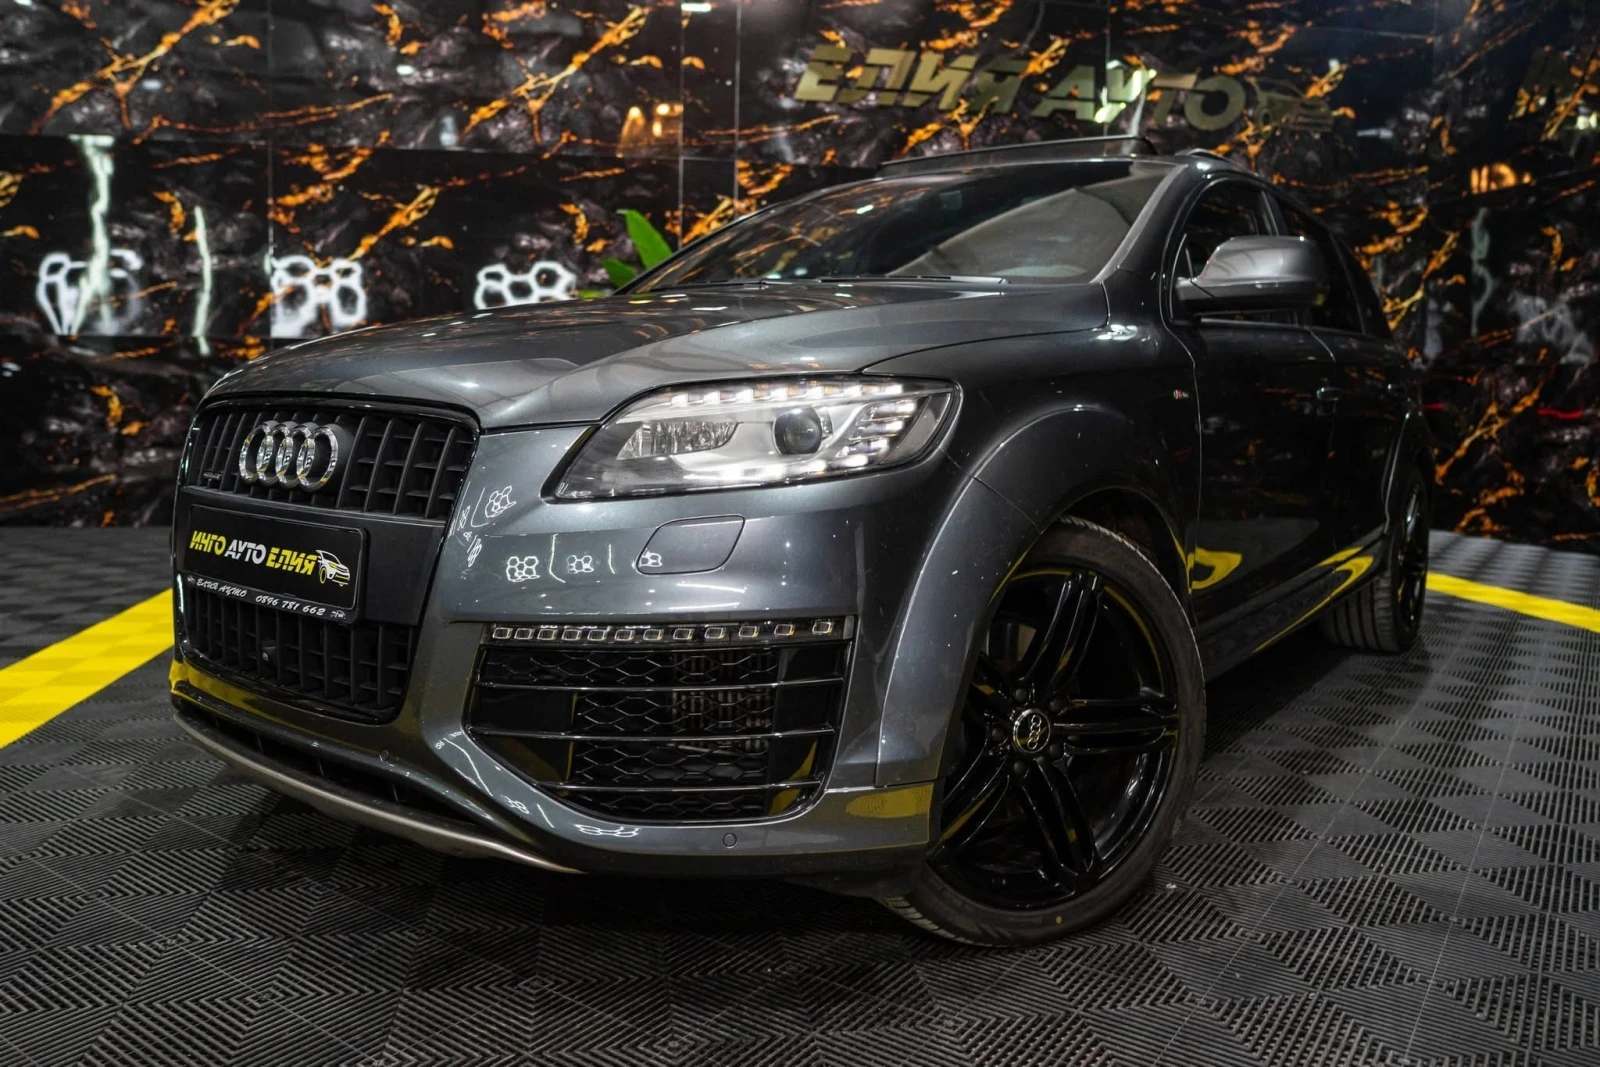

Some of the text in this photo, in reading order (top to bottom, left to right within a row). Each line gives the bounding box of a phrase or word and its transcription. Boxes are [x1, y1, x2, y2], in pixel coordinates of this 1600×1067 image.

[794, 44, 1246, 131] ЕЛИЯ АУТО
[190, 530, 318, 575] ИНГО АУТО ЕЛИЯ
[255, 595, 279, 606] 0896
[281, 600, 300, 610] 781
[302, 605, 326, 616] 662
